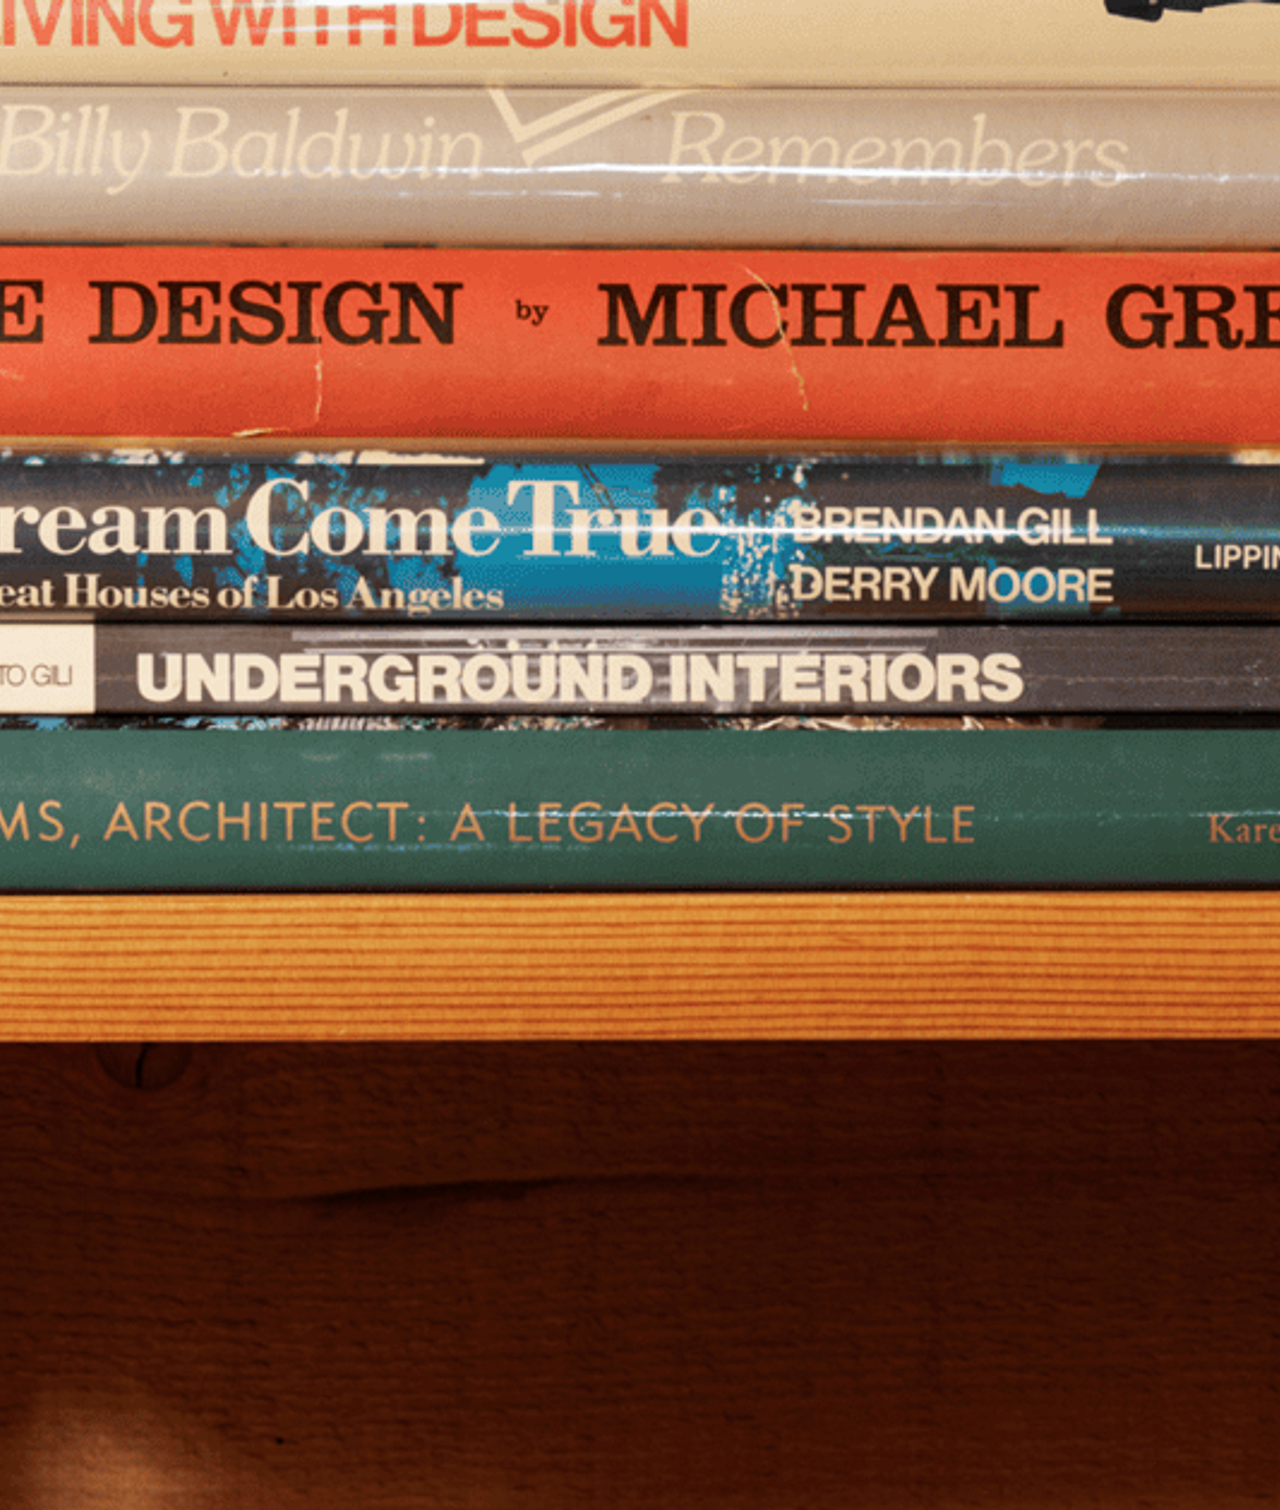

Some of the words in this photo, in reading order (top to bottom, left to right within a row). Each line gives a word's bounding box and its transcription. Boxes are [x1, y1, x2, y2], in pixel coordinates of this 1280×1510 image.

[210, 0, 396, 47] WITH
[413, 0, 688, 48] DESIGN
[165, 105, 486, 180] Baldwin
[660, 108, 1129, 190] Remembers
[87, 280, 462, 345] DESIGN
[515, 298, 548, 325] by
[597, 283, 1064, 348] MICHAEL
[245, 480, 498, 556] Come
[505, 480, 720, 558] True
[792, 505, 1007, 546] BRENDAN
[1017, 507, 1113, 546] GILL
[63, 571, 210, 610] Houses
[218, 571, 257, 610] of
[266, 571, 339, 610] Los
[348, 572, 505, 618] Angeles
[792, 566, 939, 604] DERRY
[948, 566, 1114, 604] MOORE
[32, 663, 73, 687] GILI
[136, 652, 651, 704] UNDERGROUND
[669, 652, 1024, 704] INTERIORS
[103, 801, 426, 843] ARCHITECT:
[448, 801, 485, 843] A
[509, 801, 710, 843] LEGACY
[734, 801, 807, 843] OF
[827, 801, 975, 843] STYLE
